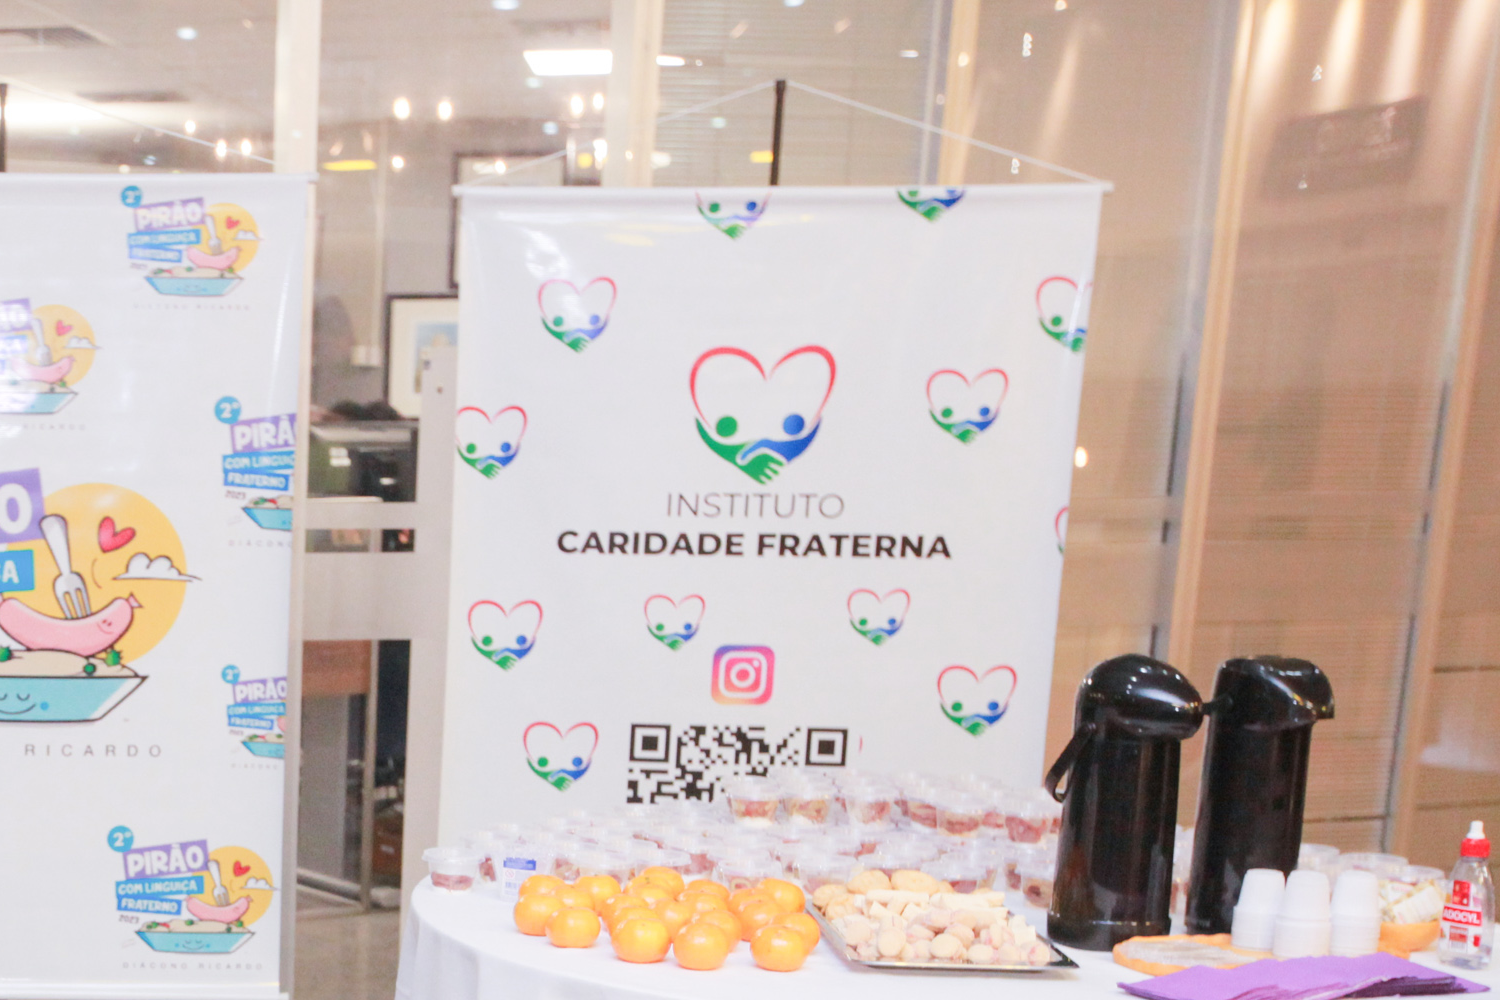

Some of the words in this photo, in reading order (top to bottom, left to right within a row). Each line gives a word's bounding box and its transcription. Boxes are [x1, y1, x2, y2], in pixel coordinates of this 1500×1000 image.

[136, 201, 203, 230] PIRÃO
[232, 414, 296, 451] PIRÃ
[224, 456, 250, 470] COM
[227, 472, 286, 489] FRATERNO
[666, 492, 845, 519] INSTITUTO
[556, 530, 745, 556] CARIDADE
[757, 533, 952, 559] FRATERNA
[24, 743, 163, 758] RICARDO
[112, 830, 132, 848] 2º
[126, 843, 205, 878] PIRÃO
[117, 883, 143, 896] COM
[144, 879, 198, 895] LINGUIÇA
[121, 897, 179, 914] FRATERNO
[1443, 907, 1480, 924] ADOCYL
